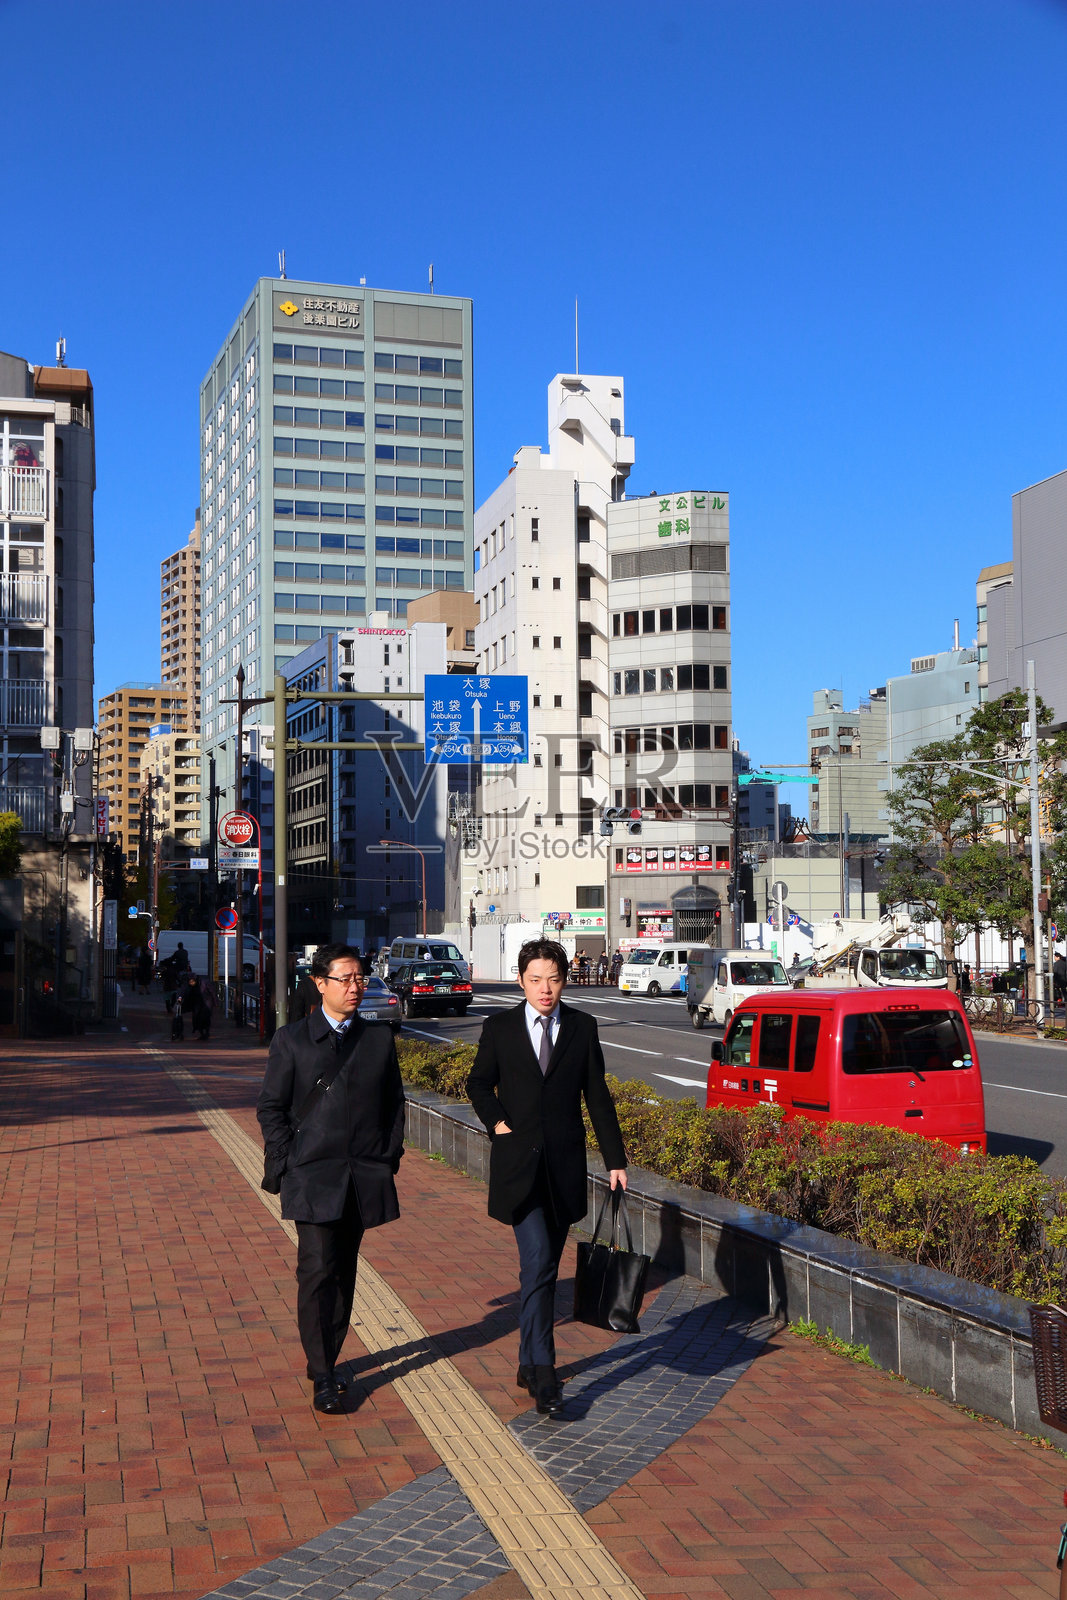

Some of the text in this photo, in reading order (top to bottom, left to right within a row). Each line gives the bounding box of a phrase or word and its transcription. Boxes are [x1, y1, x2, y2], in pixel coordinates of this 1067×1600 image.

[303, 298, 360, 314] 住友不動産
[303, 313, 360, 328] 後楽園ビル
[659, 496, 725, 512] 文公ビル
[658, 518, 690, 537] 歯科
[358, 628, 406, 636] SHINTOKYO
[462, 678, 491, 690] 大塚
[432, 700, 460, 712] 池袋
[493, 701, 520, 713] 上野
[432, 722, 461, 734] 大塚
[493, 722, 521, 734] 本郷
[435, 734, 458, 742] Otsuka
[497, 735, 518, 743] Hongo
[445, 745, 456, 754] 254
[499, 745, 511, 754] 254
[227, 824, 251, 836] 消火栓
